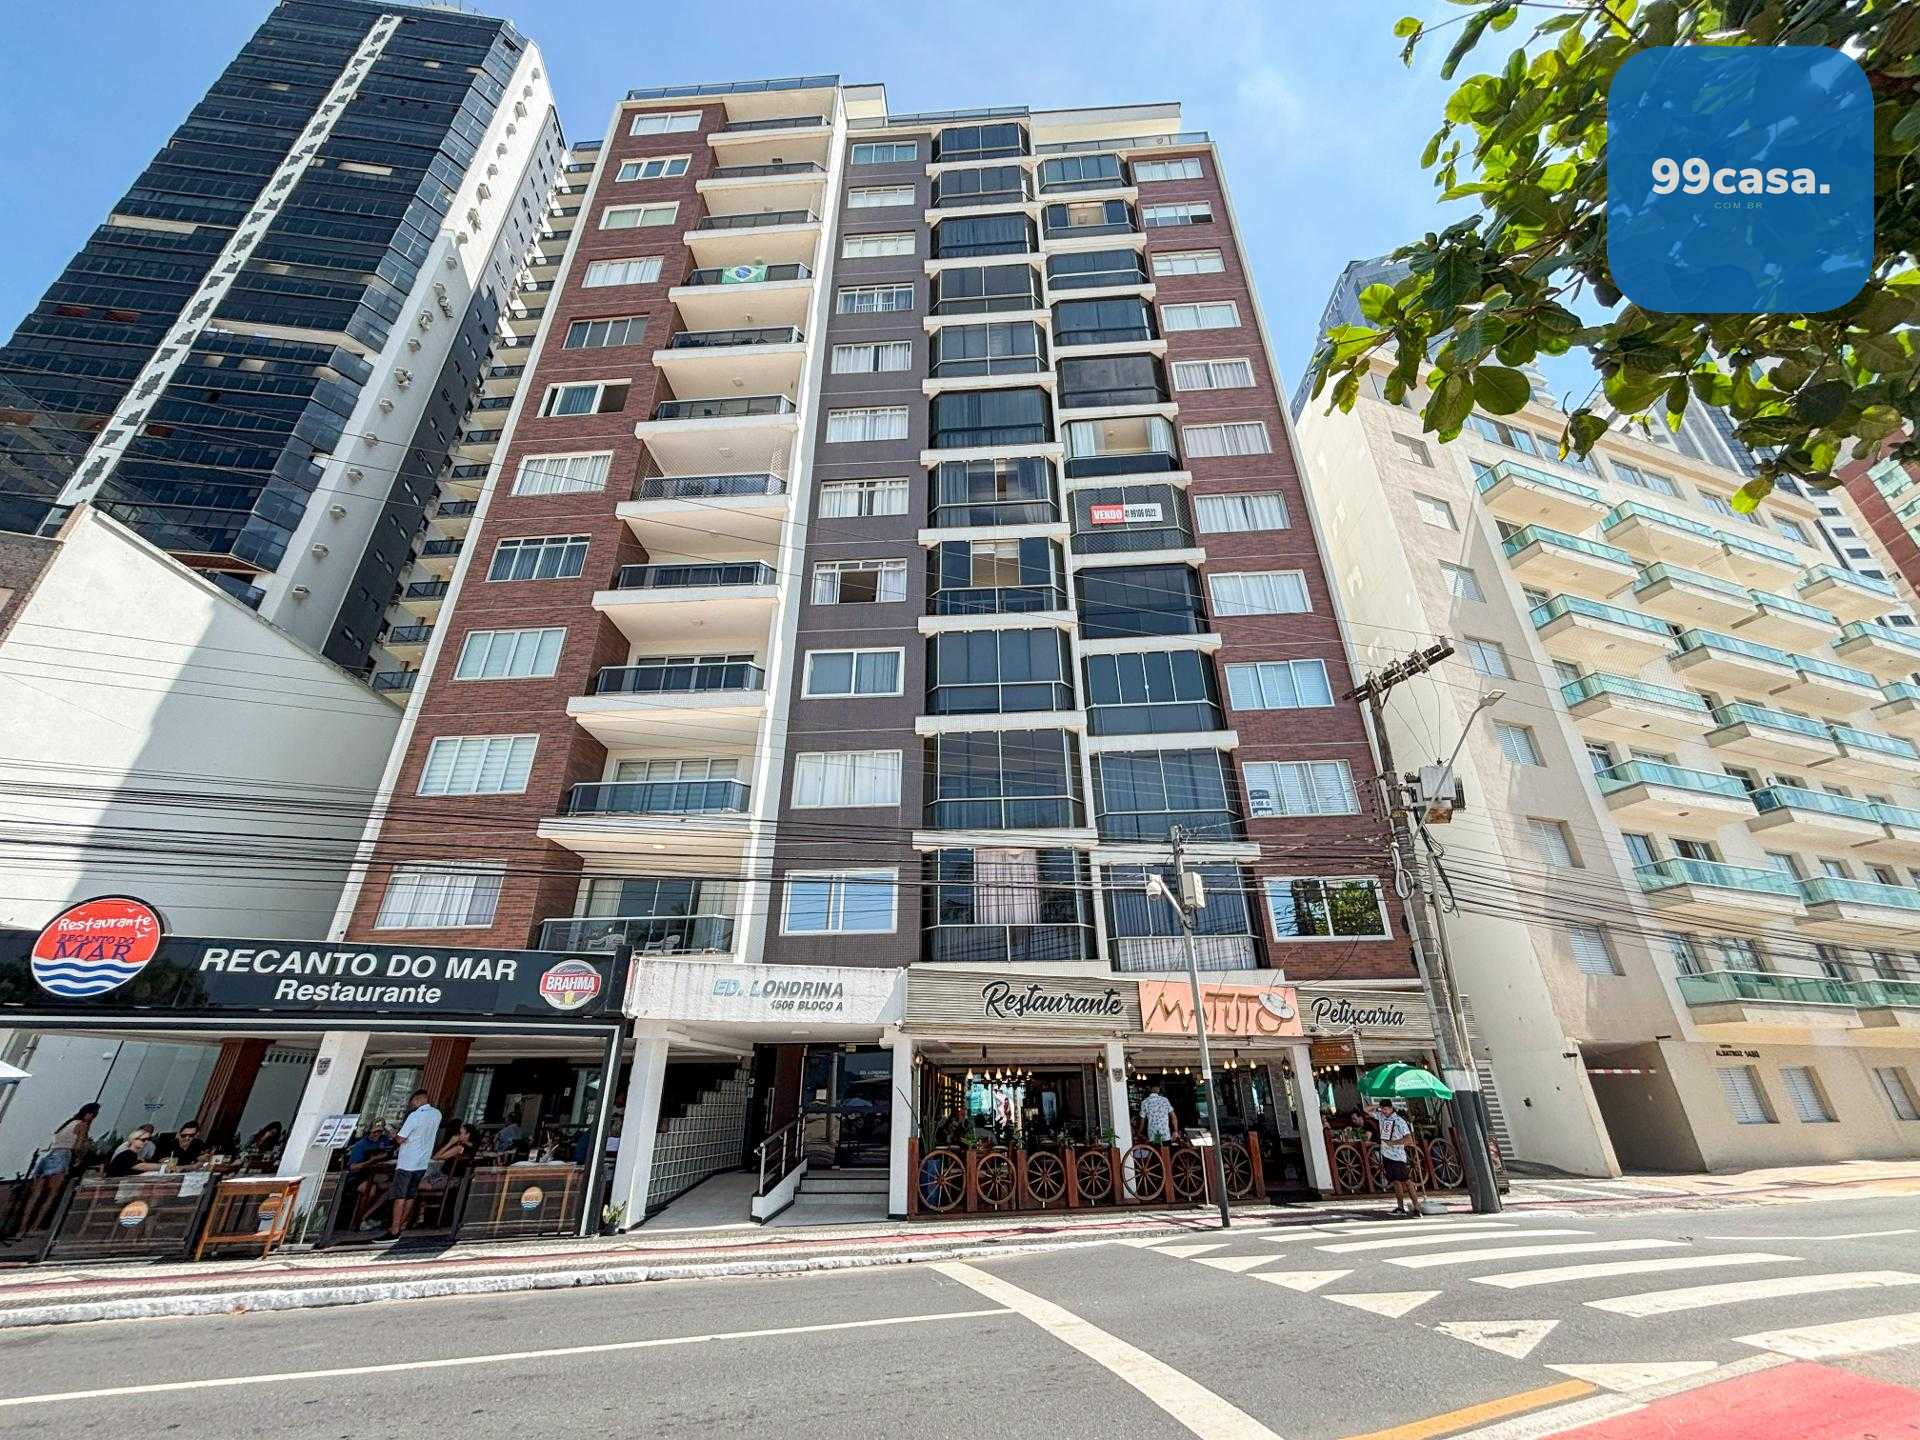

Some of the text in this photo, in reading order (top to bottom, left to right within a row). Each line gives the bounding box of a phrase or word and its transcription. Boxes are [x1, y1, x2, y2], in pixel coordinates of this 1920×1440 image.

[57, 915, 152, 932] Restaurante
[57, 933, 135, 945] RECANTO DO
[51, 941, 133, 961] MAR
[199, 948, 518, 981] RECANTO DO MAR
[274, 979, 442, 1004] Restaurante
[546, 975, 595, 991] BRAHMA
[749, 980, 843, 998] LONDRINA
[797, 1001, 833, 1011] BLOCO
[836, 1001, 843, 1011] A
[981, 981, 1124, 1018] Restaurante
[1310, 997, 1405, 1026] Petiscaria
